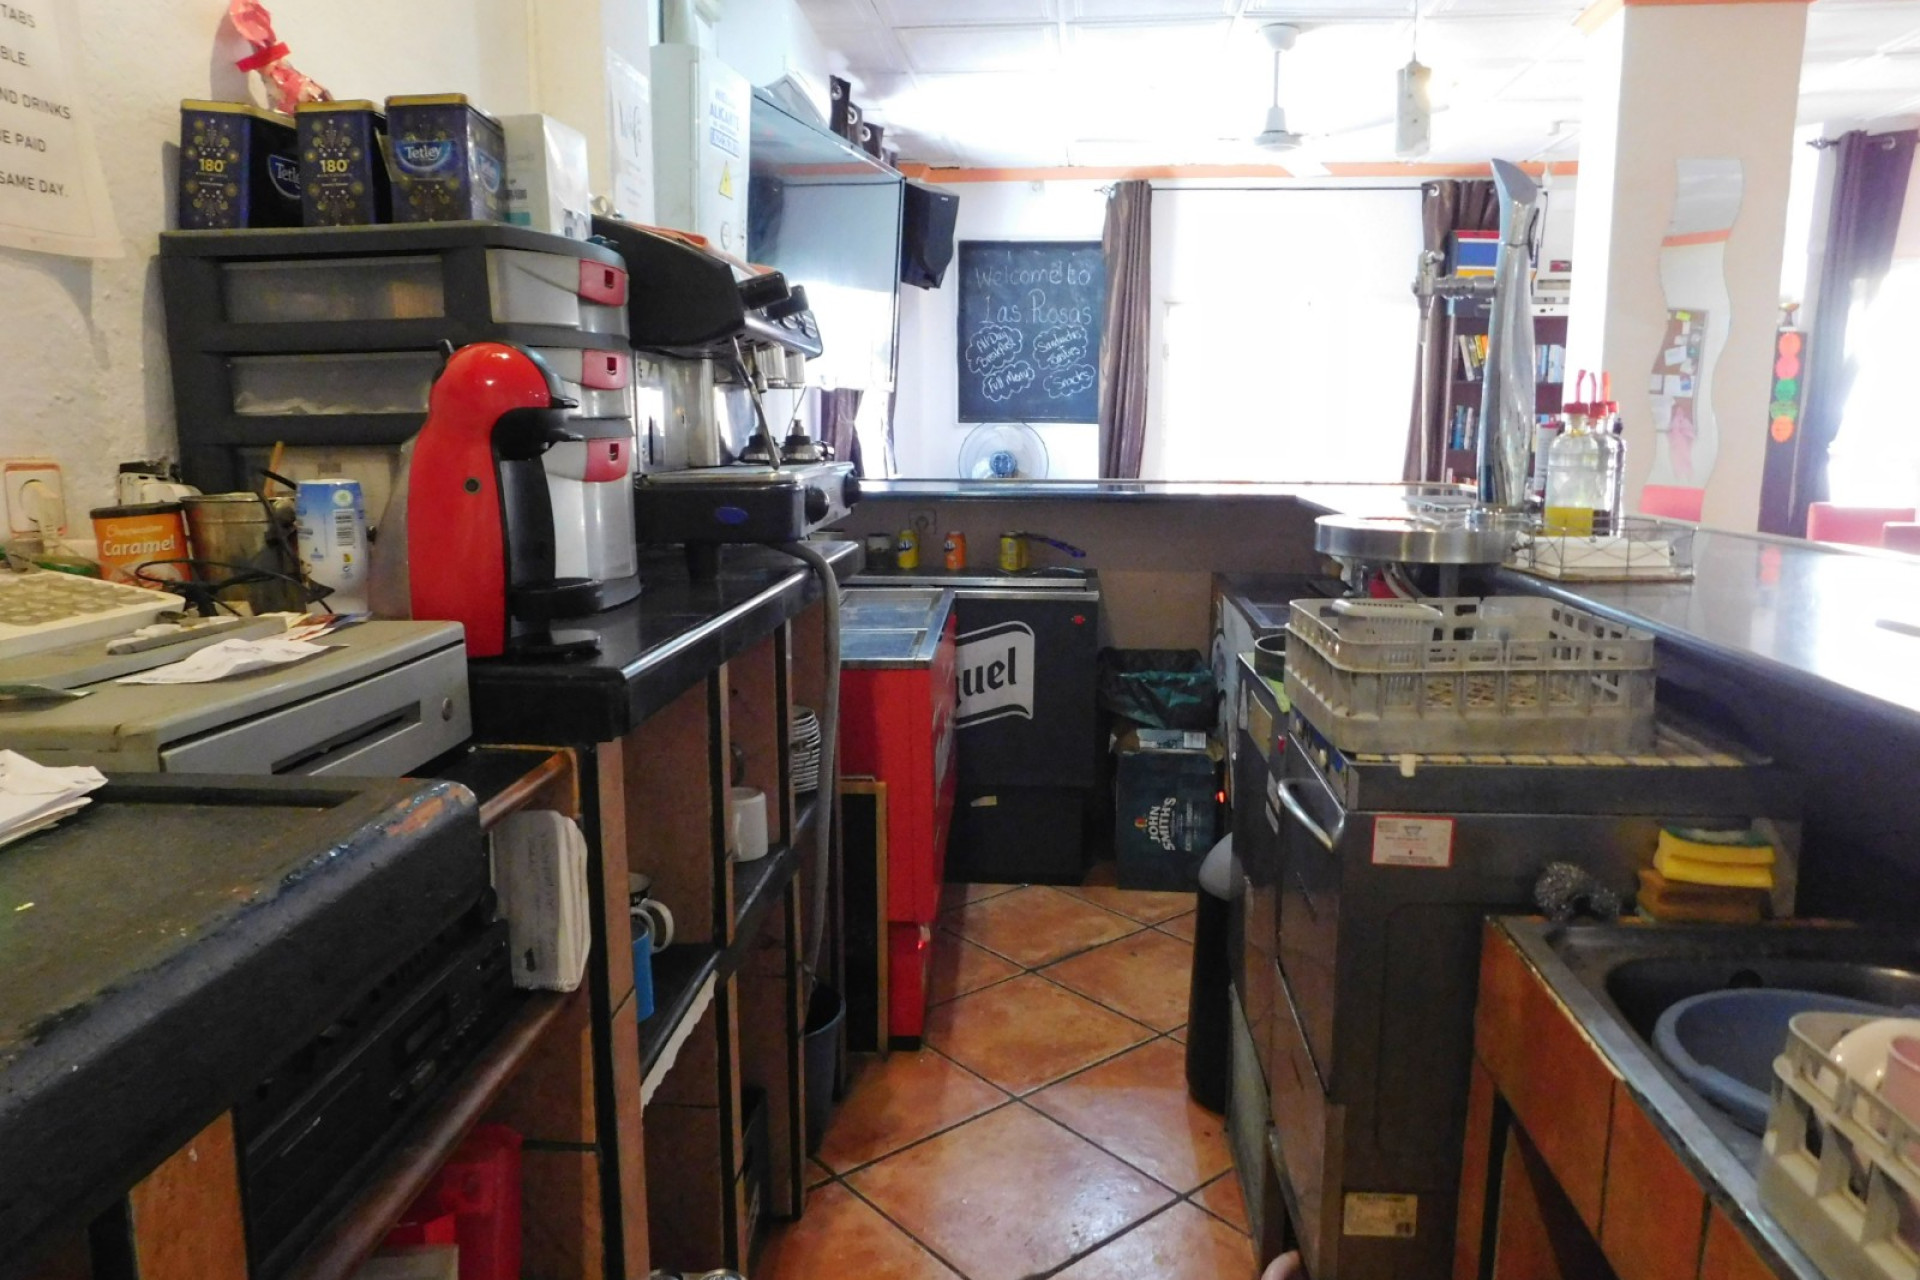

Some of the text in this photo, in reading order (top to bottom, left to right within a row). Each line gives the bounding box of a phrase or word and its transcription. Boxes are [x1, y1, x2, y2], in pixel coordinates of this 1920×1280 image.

[1, 3, 36, 28] TABS
[22, 94, 71, 119] DRINKS
[16, 133, 46, 152] PAID
[404, 146, 440, 160] Tetley
[0, 171, 69, 198] SAME DAY.
[1028, 288, 1092, 325] Rosas
[103, 533, 175, 556] Caramel
[956, 646, 1017, 709] uel
[1148, 805, 1161, 843] JOHN
[1158, 797, 1177, 851] SMITH'S
